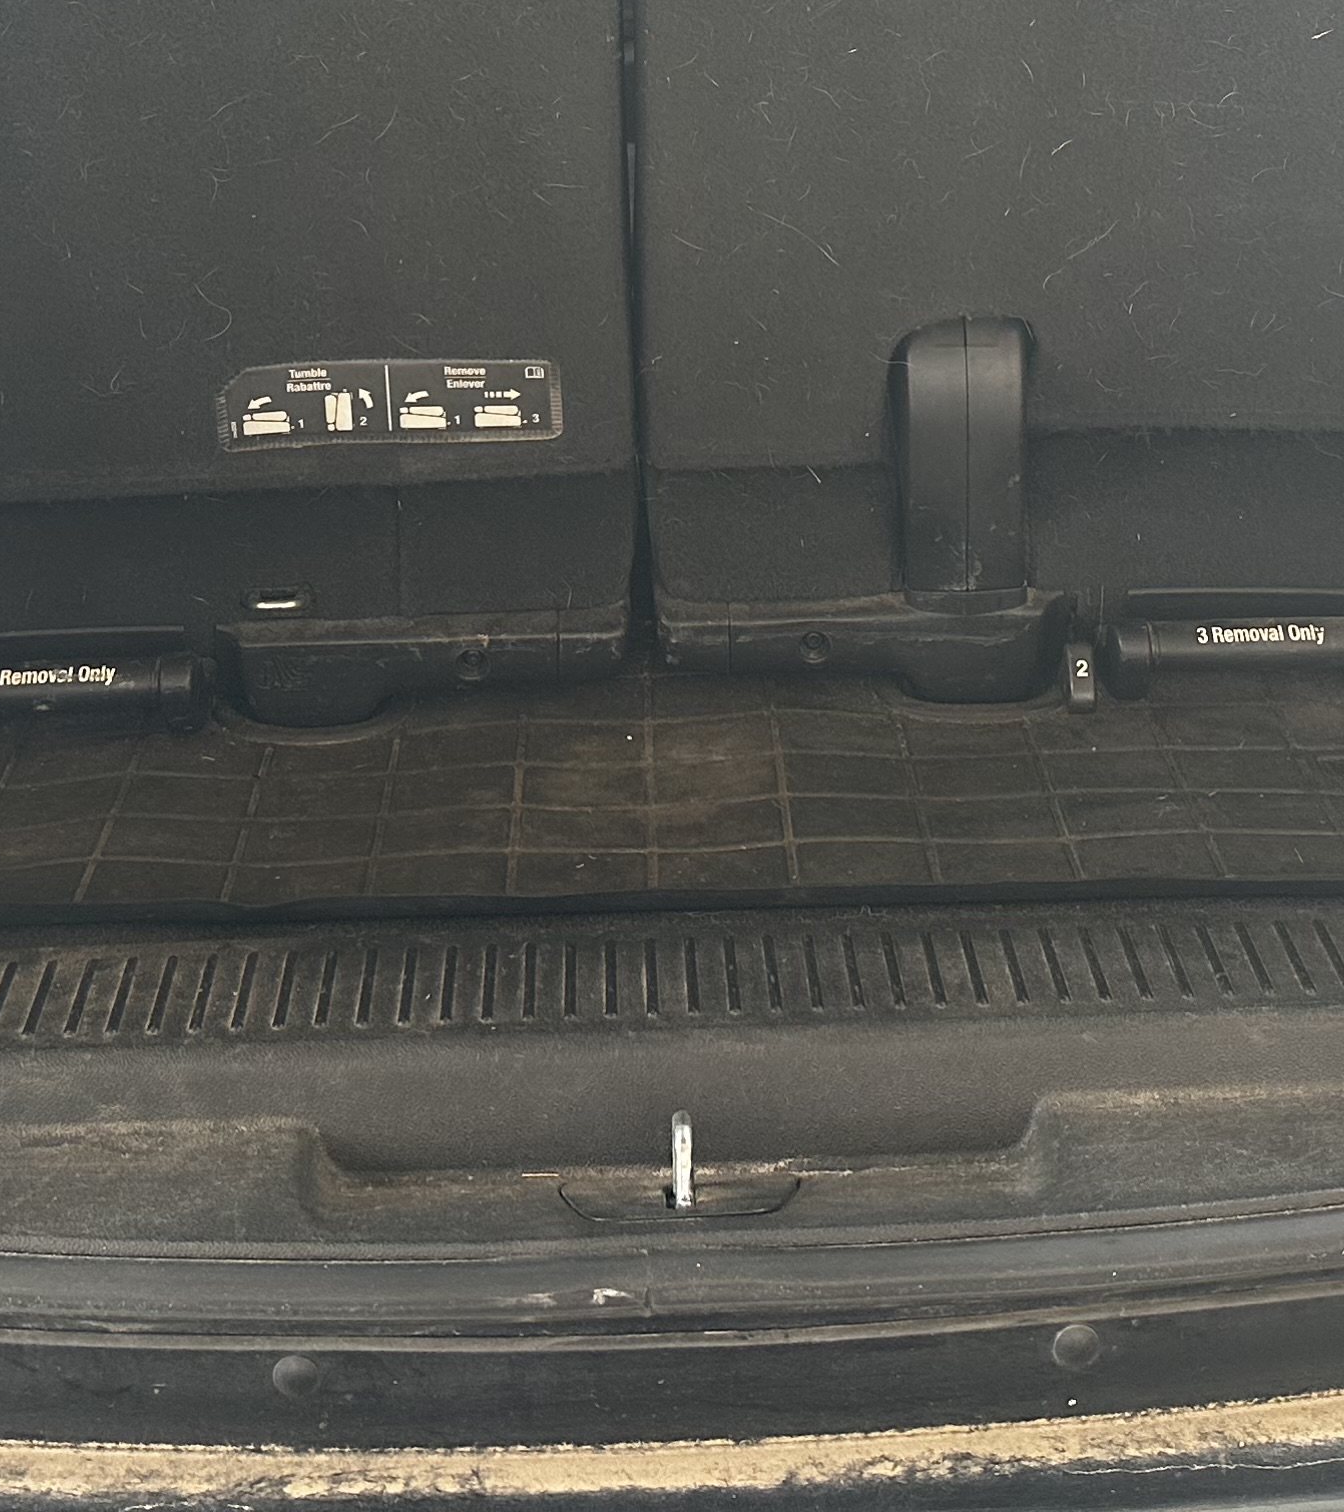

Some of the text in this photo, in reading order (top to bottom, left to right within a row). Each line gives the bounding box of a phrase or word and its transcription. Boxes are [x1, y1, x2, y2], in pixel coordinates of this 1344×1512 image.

[288, 368, 327, 379] Tumble
[443, 366, 486, 376] Remove
[286, 382, 332, 393] Rabattre
[446, 379, 485, 389] Enlever
[359, 416, 368, 426] 2
[453, 414, 461, 425] 1
[531, 413, 540, 423] 3
[297, 419, 304, 429] 1
[1196, 624, 1325, 645] 3 Removal Only
[1075, 659, 1089, 677] 2
[0, 666, 74, 686] Removal
[78, 664, 116, 686] Only
